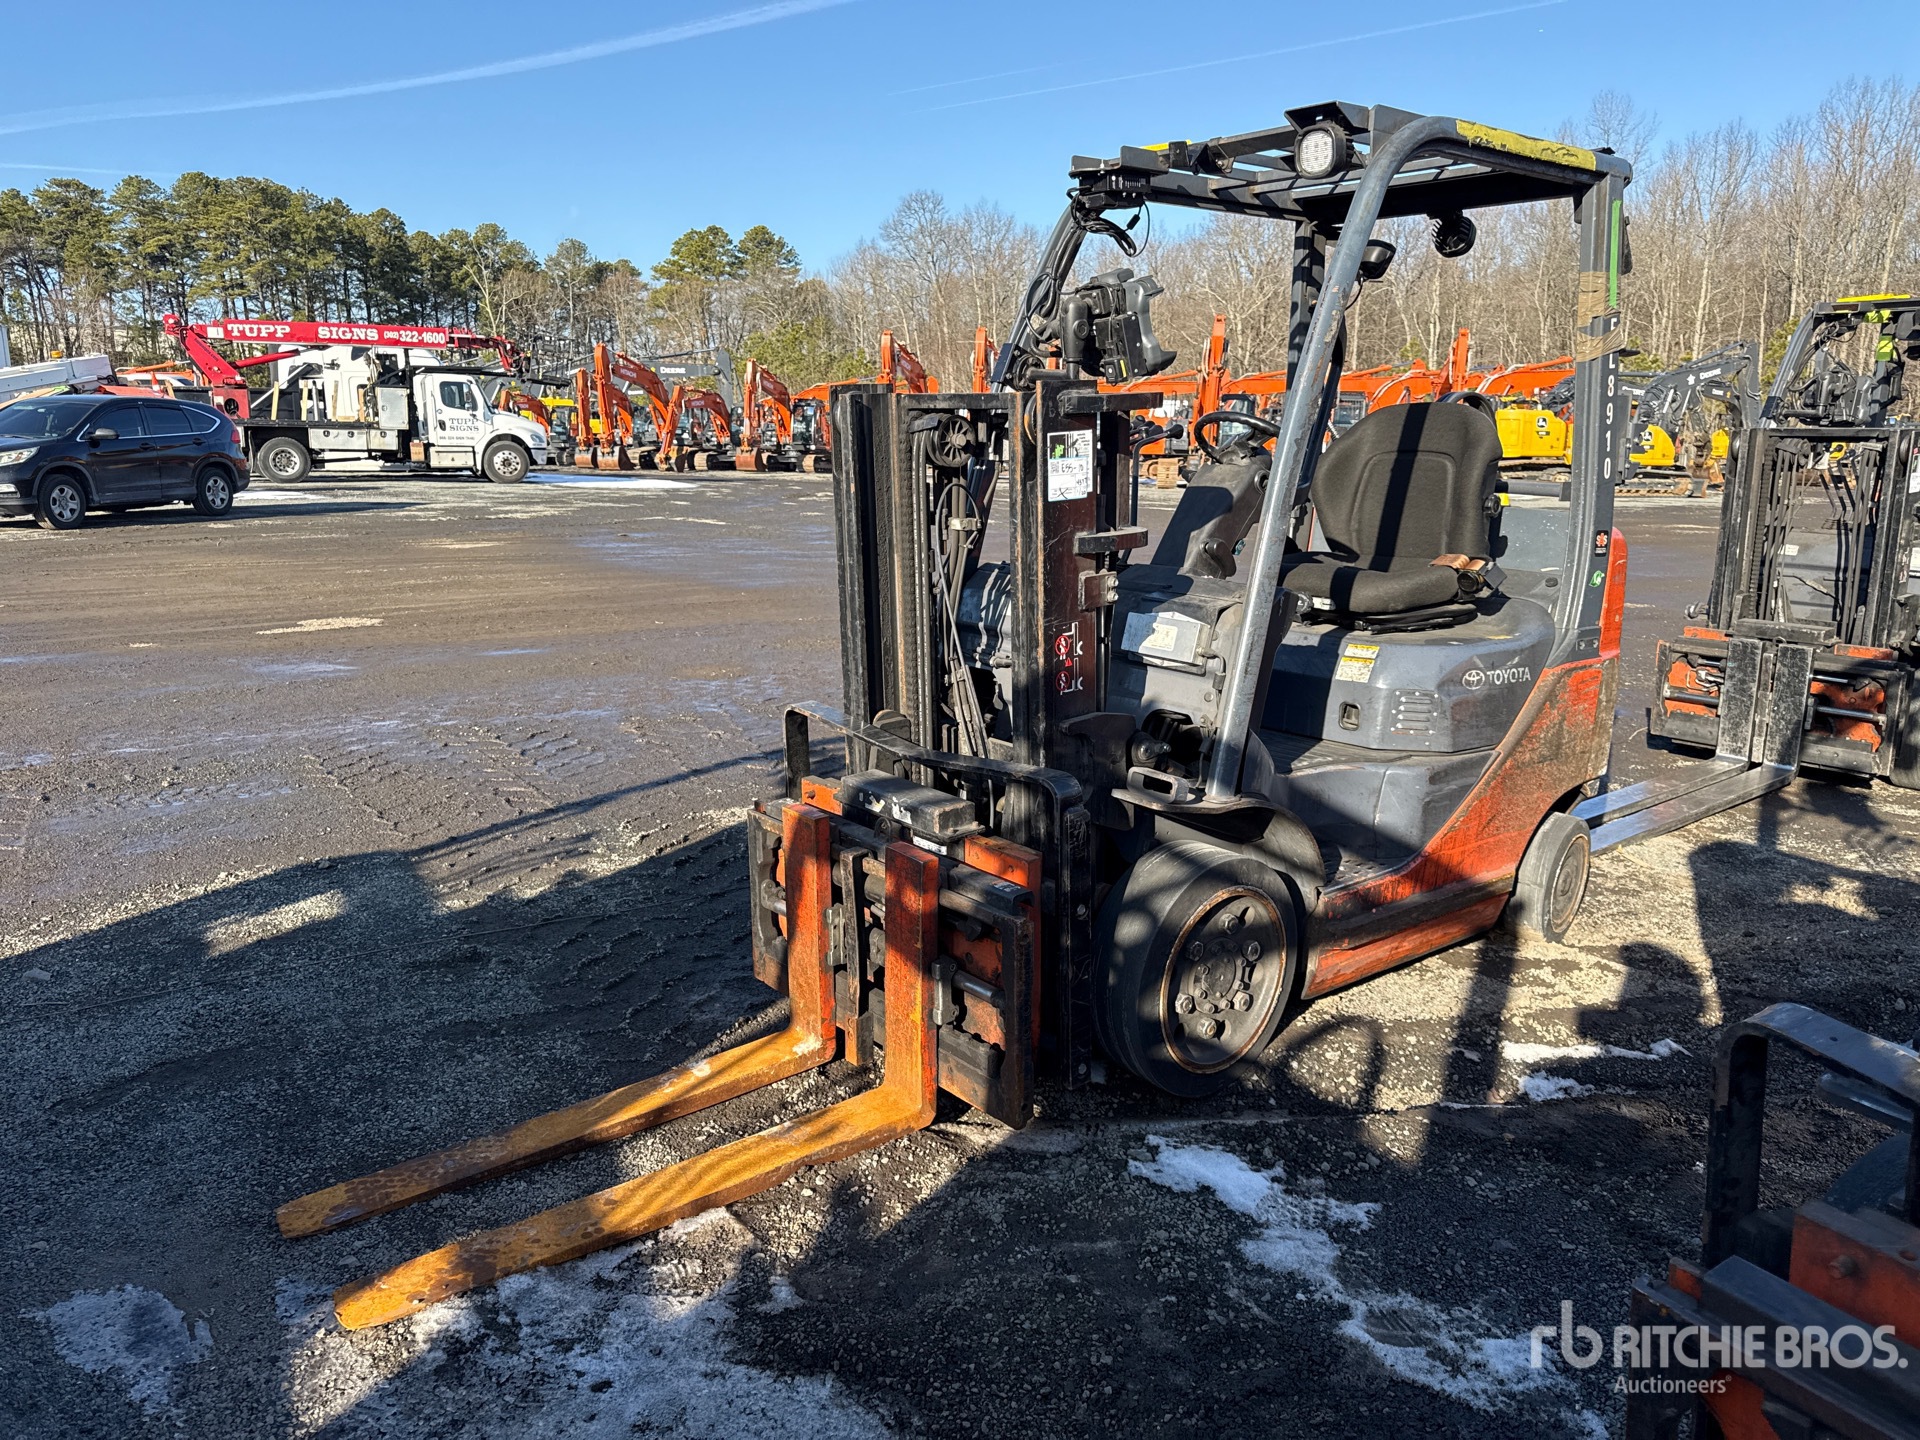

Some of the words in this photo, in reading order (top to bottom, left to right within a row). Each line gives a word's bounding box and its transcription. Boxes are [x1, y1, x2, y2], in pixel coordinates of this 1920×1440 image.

[227, 324, 291, 338] TUPP
[318, 326, 379, 341] SIGNS
[400, 330, 446, 345] 322-1600
[449, 417, 479, 425] TUPP
[1486, 666, 1532, 685] TOYOTA
